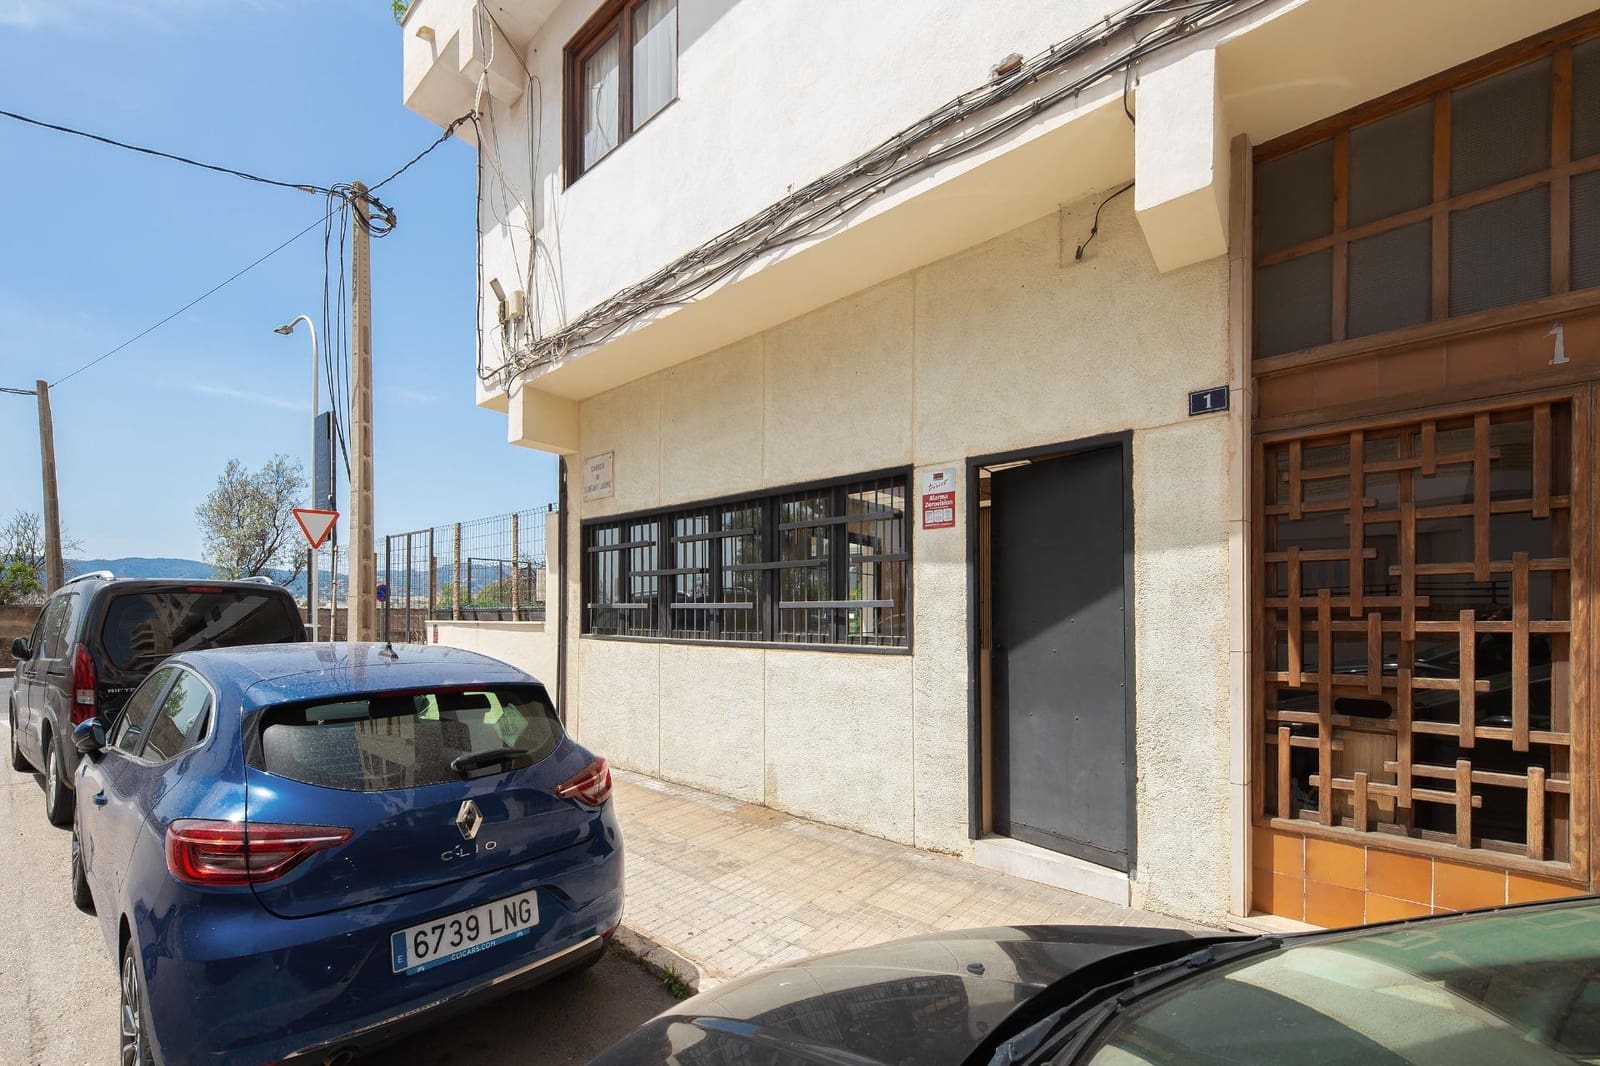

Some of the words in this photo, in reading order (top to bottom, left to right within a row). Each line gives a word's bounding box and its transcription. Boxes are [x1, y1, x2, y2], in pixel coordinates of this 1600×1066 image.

[1544, 322, 1570, 366] 1
[1203, 393, 1212, 409] 1
[929, 494, 949, 502] Alarma
[441, 840, 497, 861] CLIO
[413, 914, 480, 959] 6739
[488, 898, 532, 936] LNG
[397, 955, 403, 964] E
[451, 940, 497, 961] CLICARS.COM
